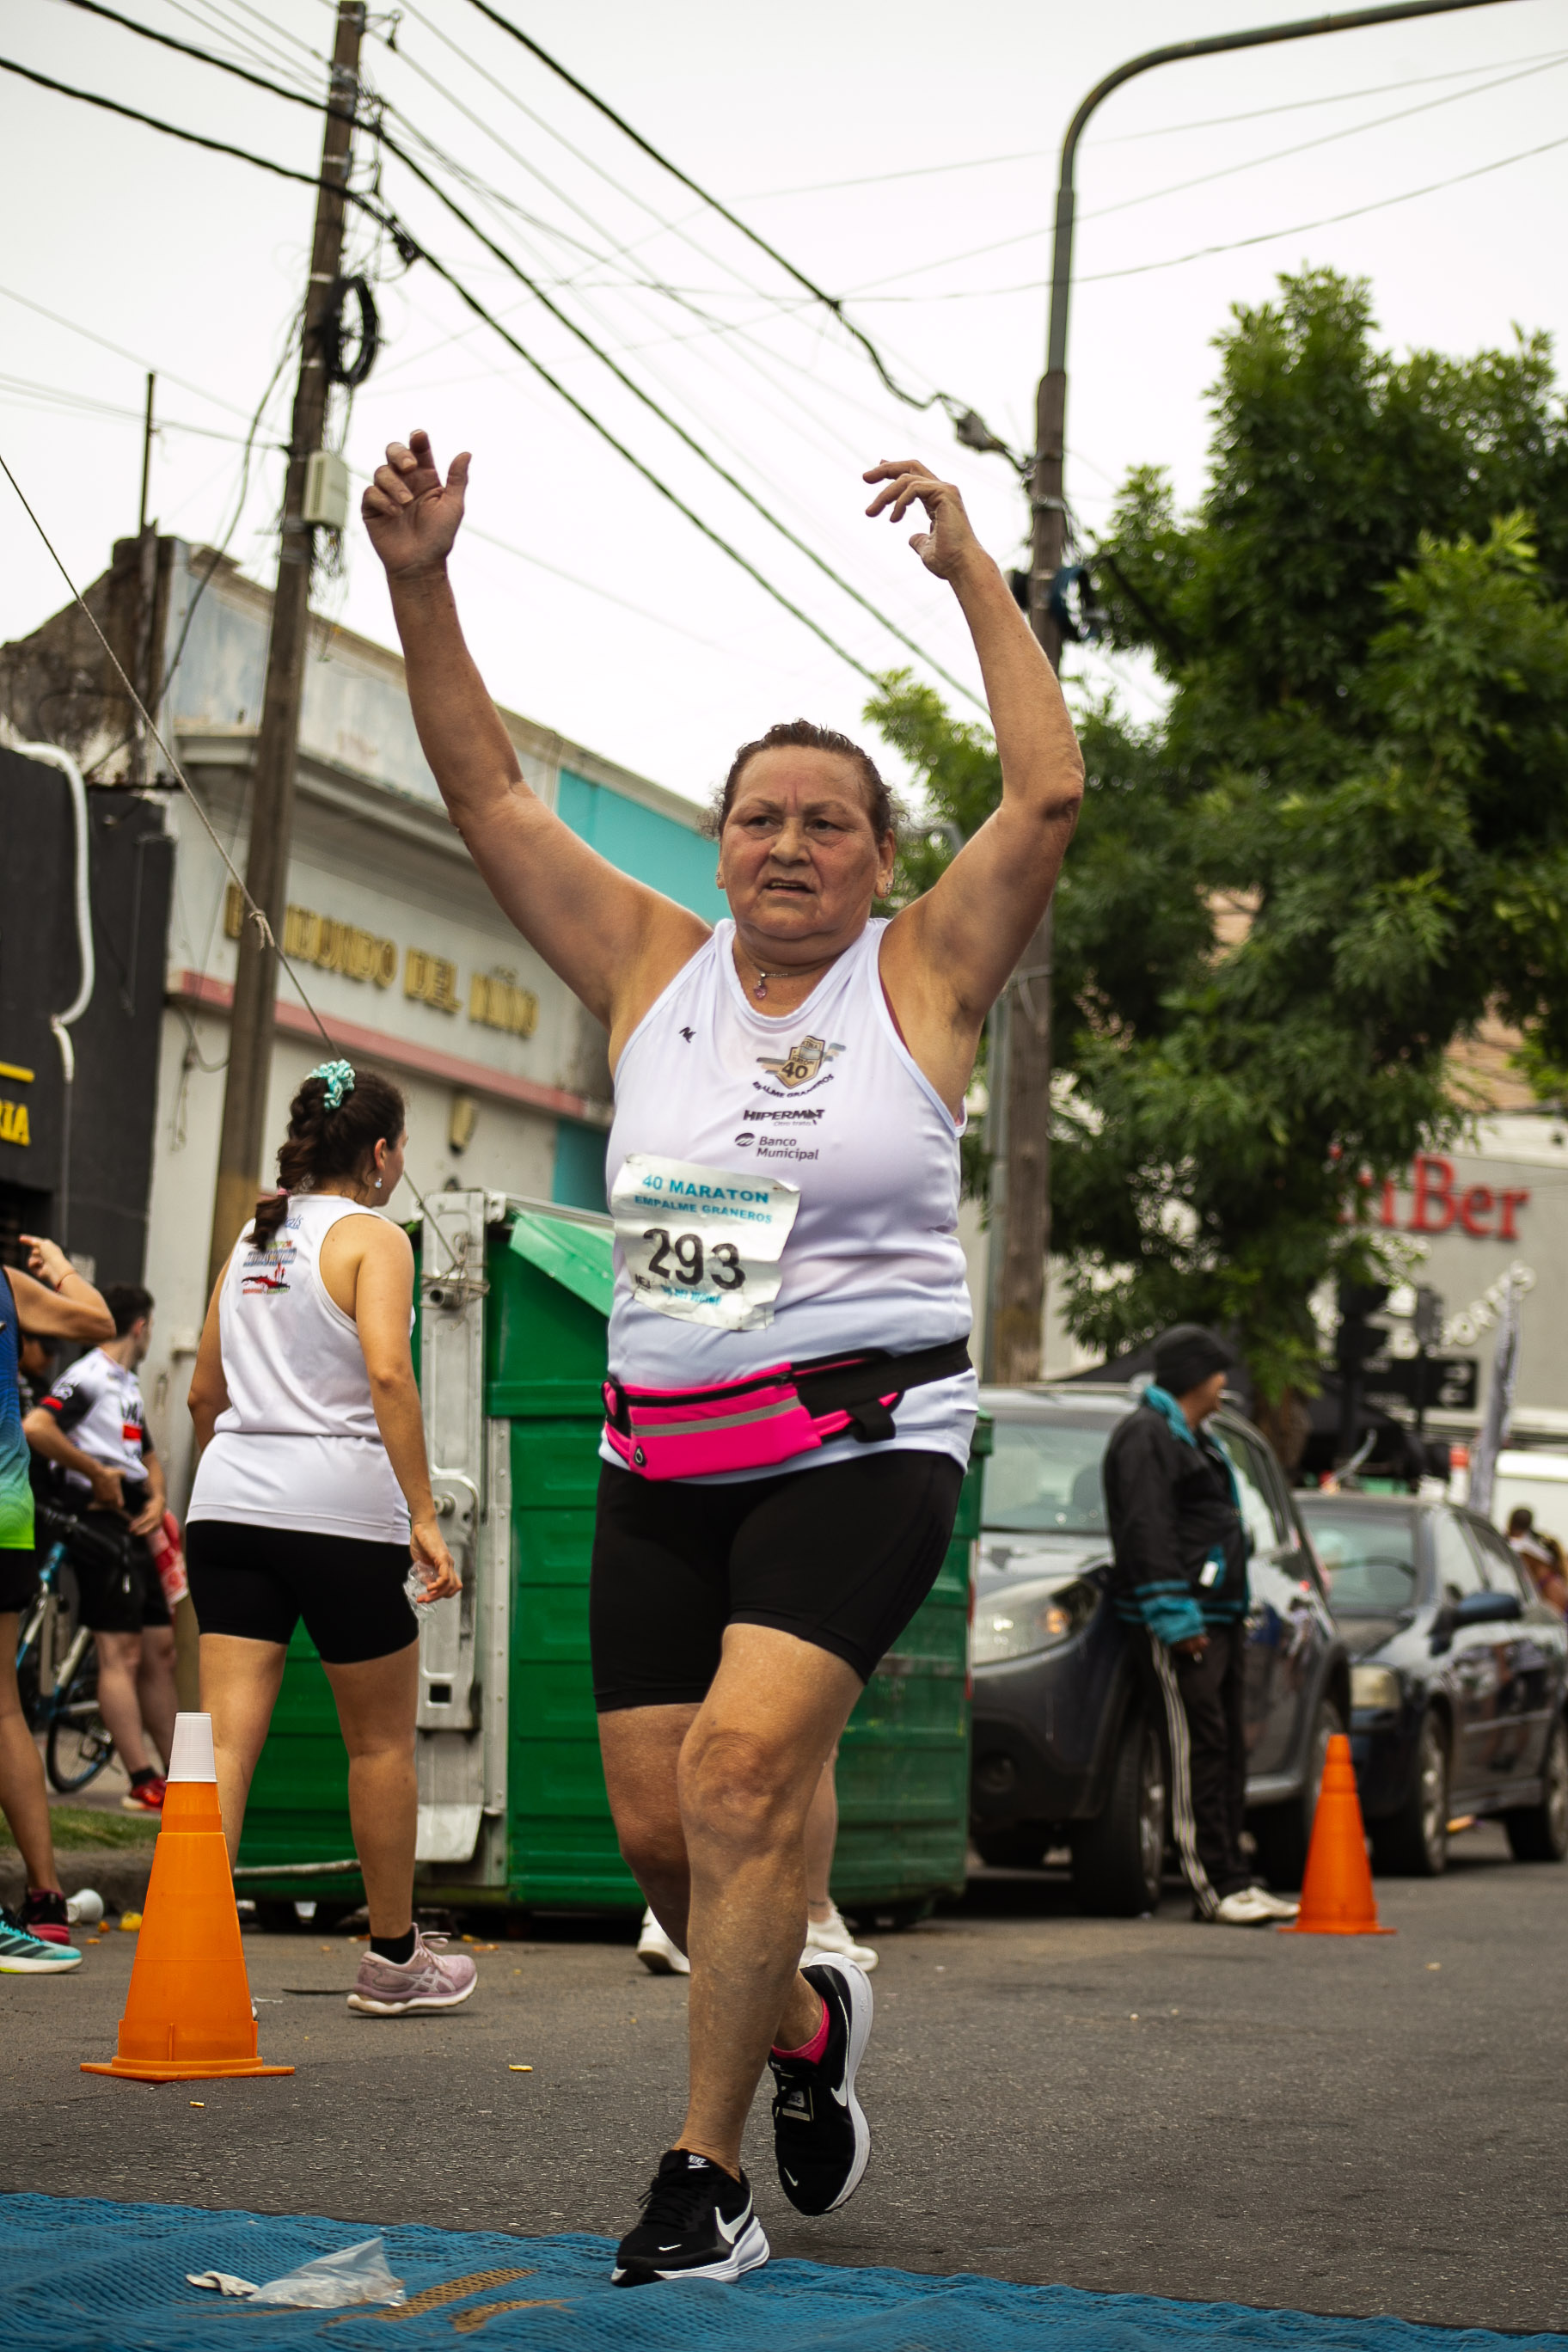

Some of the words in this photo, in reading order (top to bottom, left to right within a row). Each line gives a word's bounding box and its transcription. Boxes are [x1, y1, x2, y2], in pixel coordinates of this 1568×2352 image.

[781, 1062, 808, 1079] 40
[759, 1136, 797, 1147] Banco
[756, 1148, 819, 1161] Municipal
[642, 1174, 663, 1191] 40
[669, 1179, 769, 1204] MARATON
[634, 1195, 697, 1213] EMPALME
[701, 1204, 772, 1224] GRANEROS
[643, 1228, 746, 1290] 293
